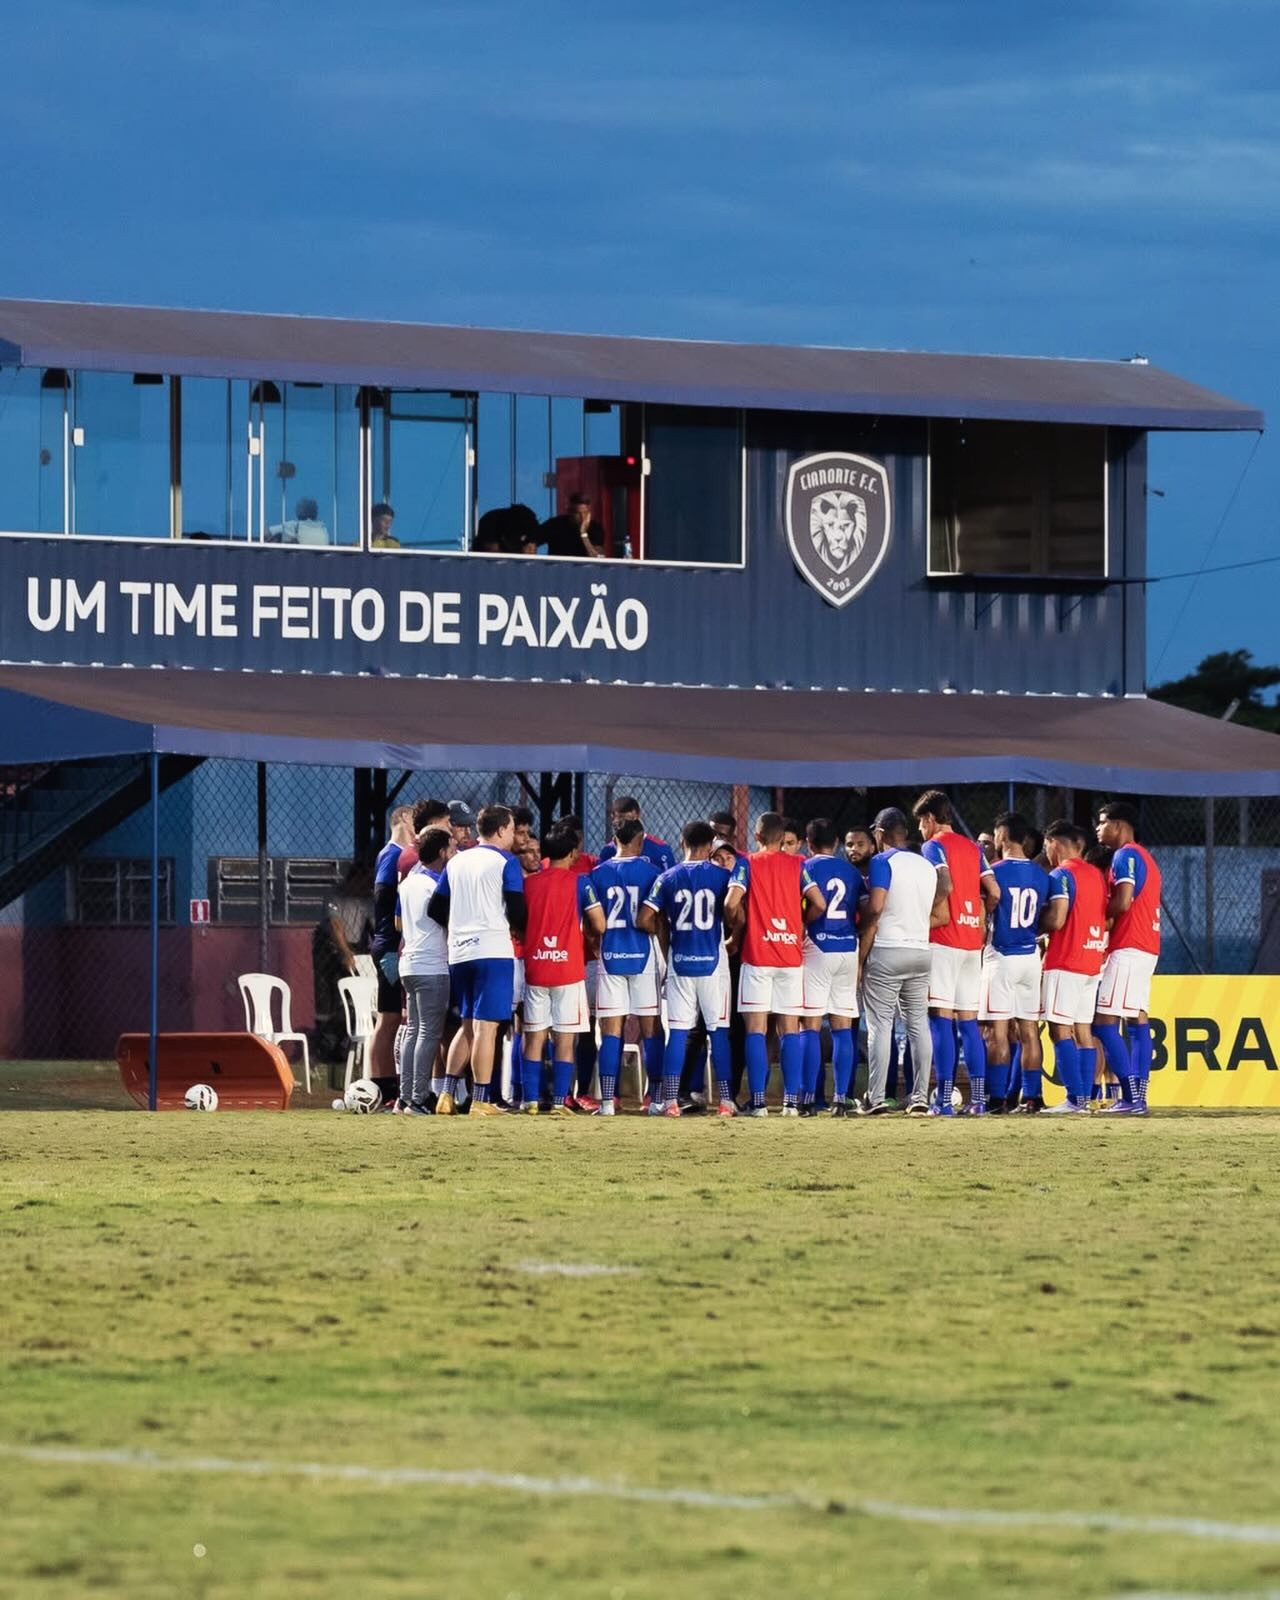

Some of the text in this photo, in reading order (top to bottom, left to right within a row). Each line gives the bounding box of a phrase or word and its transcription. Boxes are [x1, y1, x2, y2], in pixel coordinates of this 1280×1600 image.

[800, 468, 858, 490] CIANORTE
[26, 577, 649, 651] UM TIME FEITO DE PAIXÃO
[606, 886, 640, 929] 21
[674, 888, 716, 931] 20
[826, 877, 847, 920] 2
[1008, 887, 1038, 929] 10
[533, 949, 568, 962] Junpe
